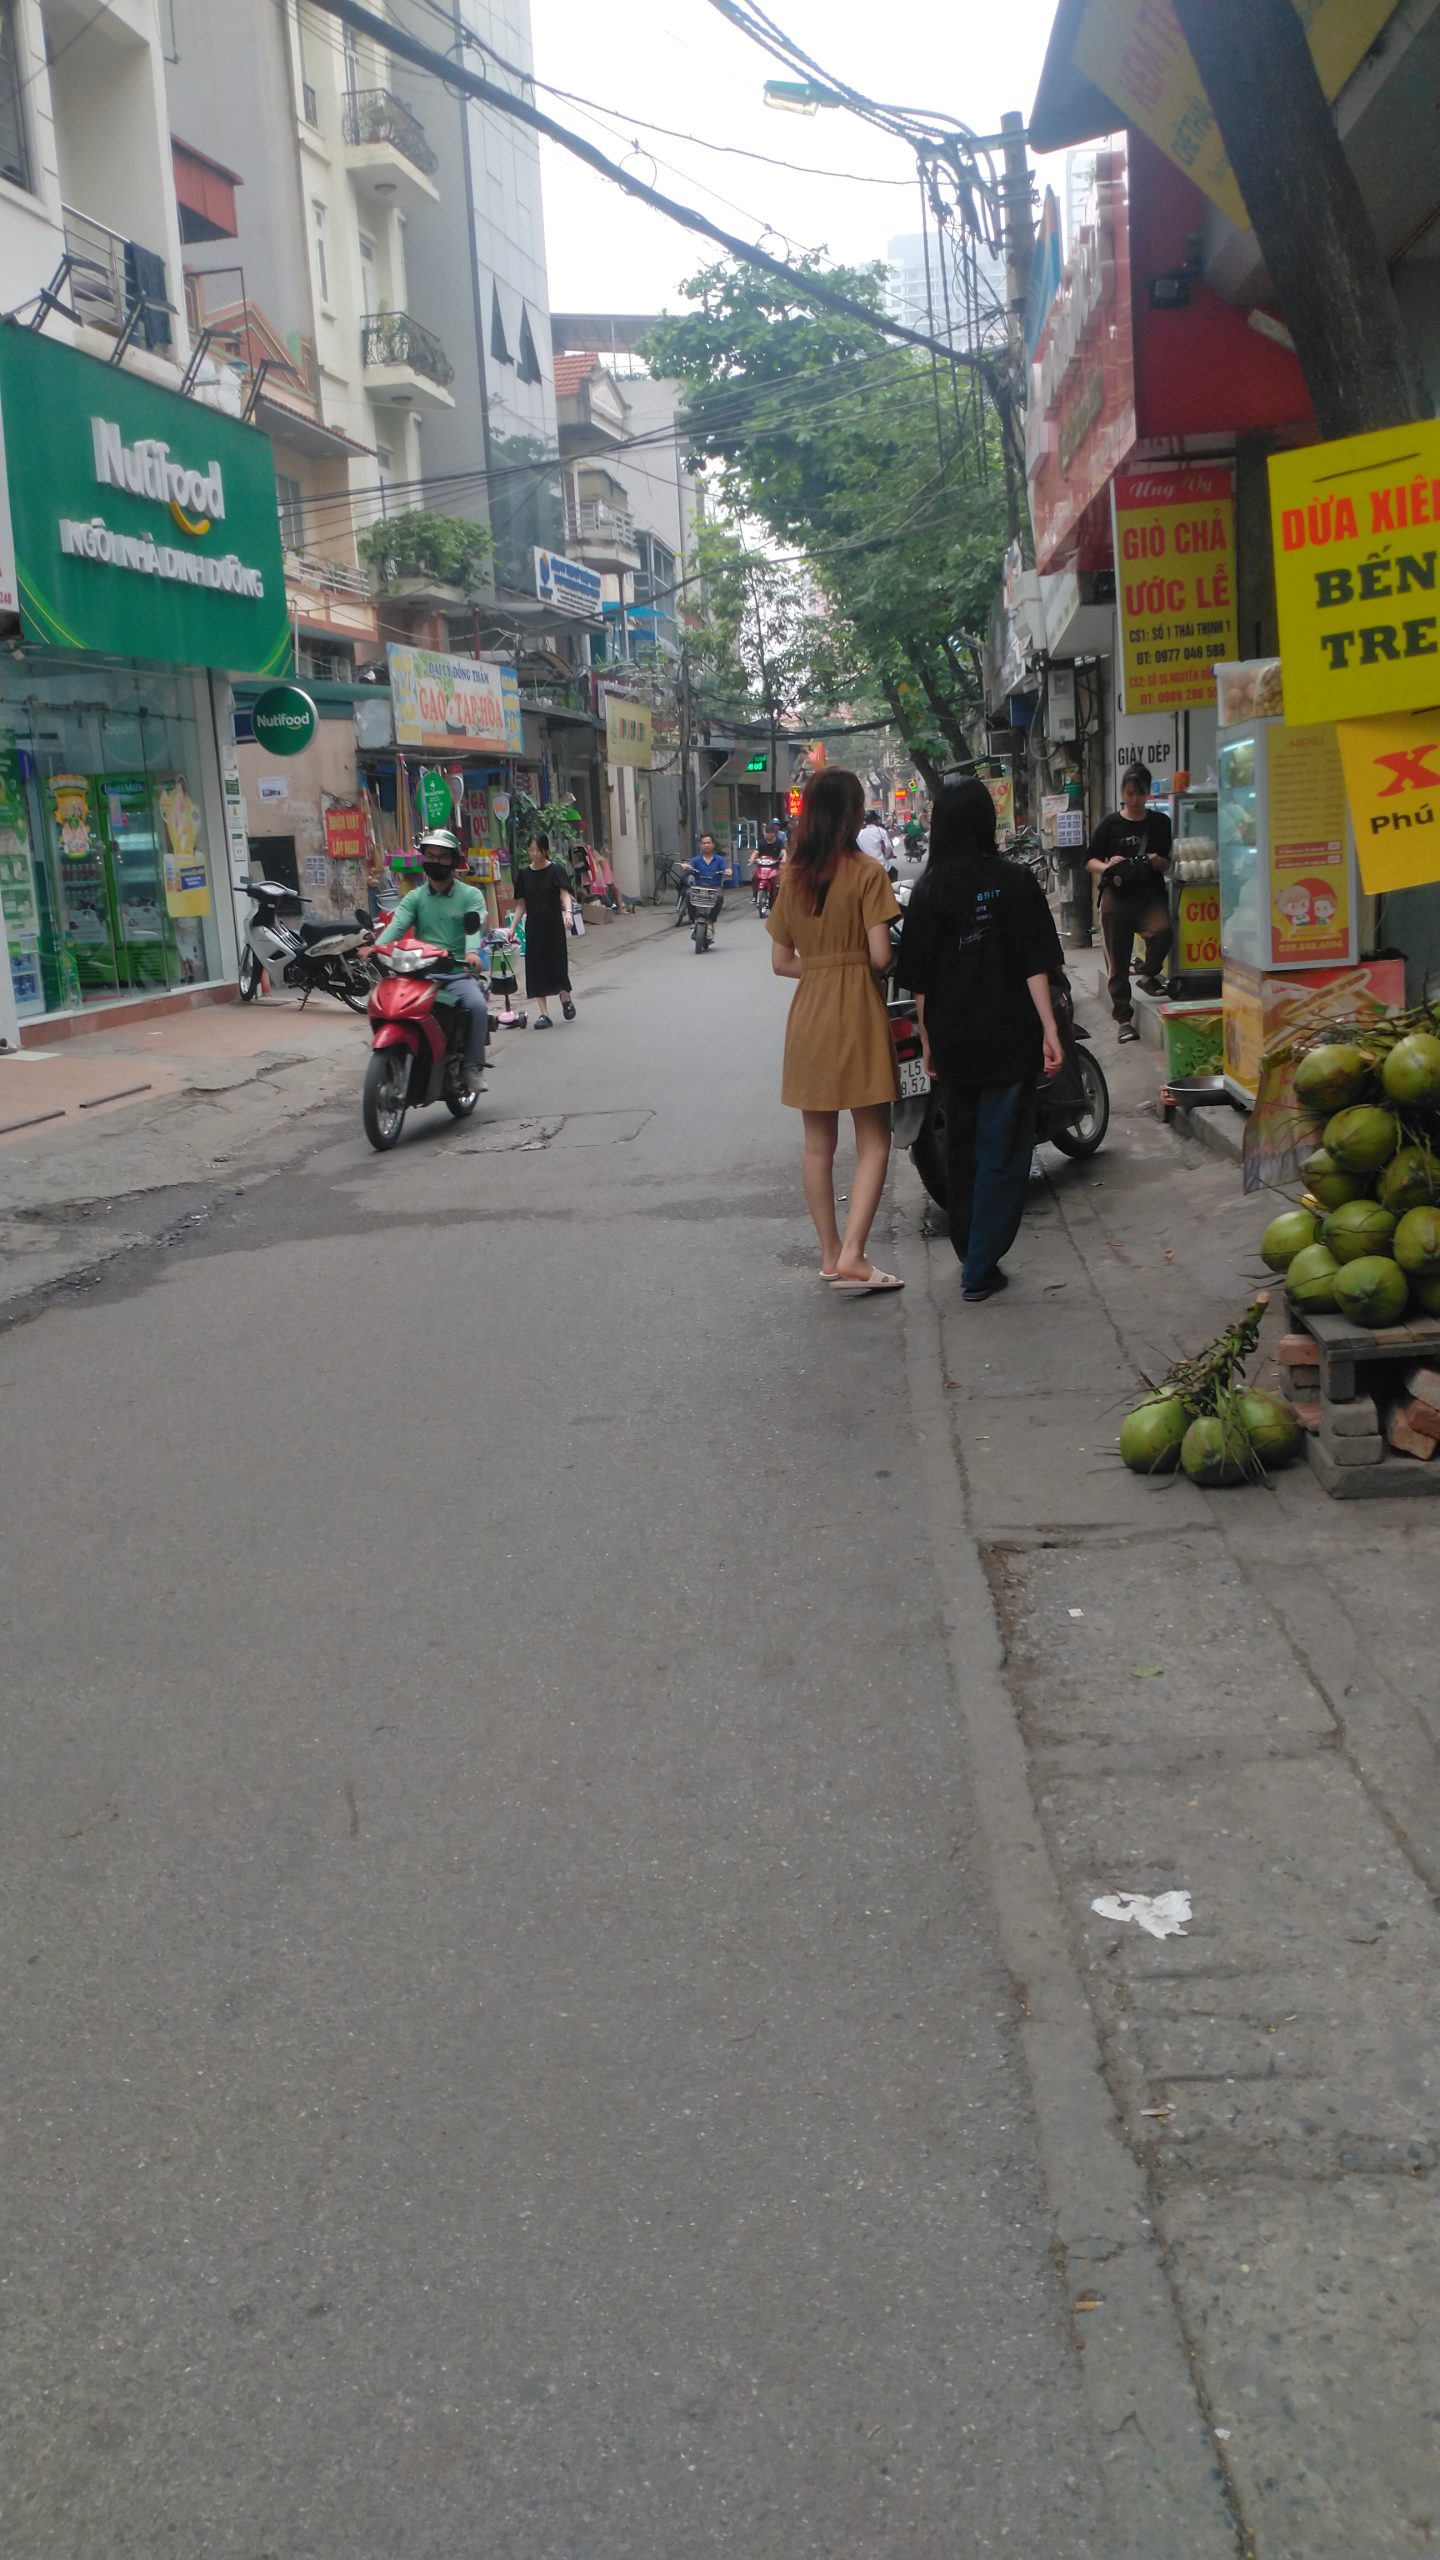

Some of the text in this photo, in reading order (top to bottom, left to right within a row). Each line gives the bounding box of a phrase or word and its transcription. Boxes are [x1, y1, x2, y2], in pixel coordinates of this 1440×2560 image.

[91, 417, 225, 519] Nutifood
[1122, 507, 1227, 560] GIÒ CHẢ
[1281, 493, 1359, 552] DỪA
[59, 518, 116, 563] NGÔI
[114, 532, 160, 577] NHÀ
[158, 547, 205, 587] DINH
[1314, 544, 1438, 609] BẾN
[1125, 563, 1230, 616] ƯỚC LỄ
[1321, 616, 1438, 670] TRE
[257, 712, 310, 728] Nutifood
[1118, 740, 1170, 765] GIÀY DÉP
[1370, 803, 1434, 835] Phú
[1186, 896, 1219, 922] GIÒ
